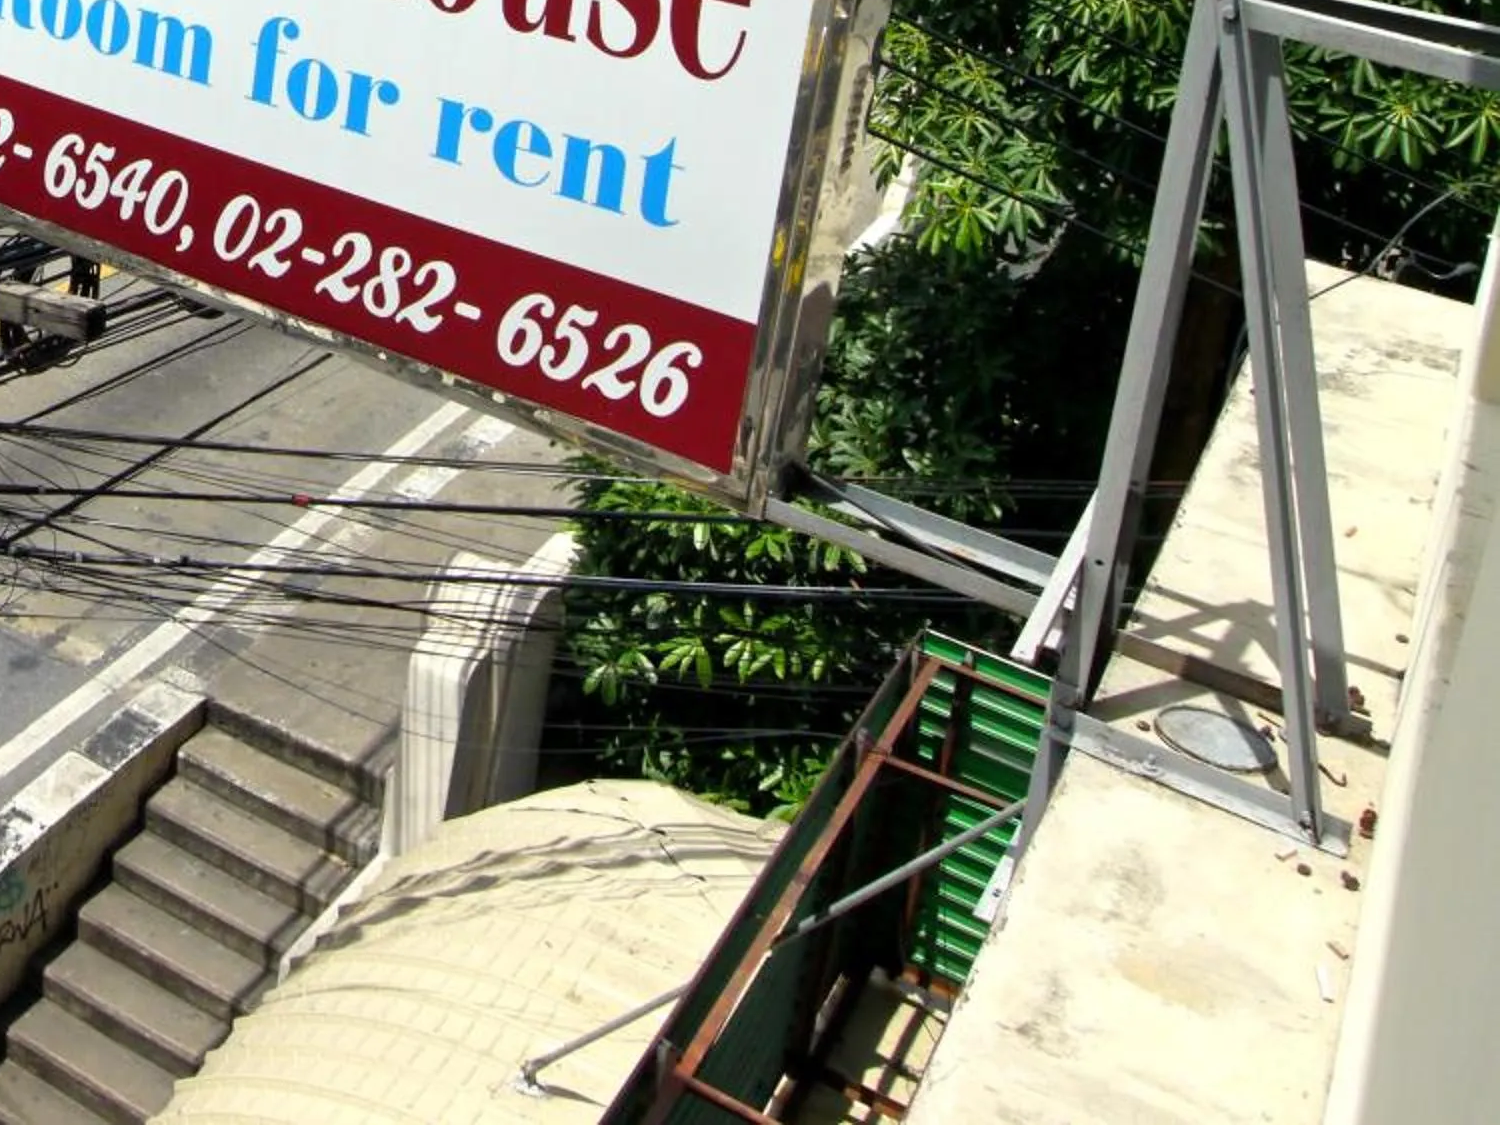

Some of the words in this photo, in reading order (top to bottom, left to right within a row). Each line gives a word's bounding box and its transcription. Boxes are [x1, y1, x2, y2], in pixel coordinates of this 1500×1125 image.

[244, 15, 402, 136] for
[433, 97, 684, 230] rent
[496, 293, 703, 418] 6526
